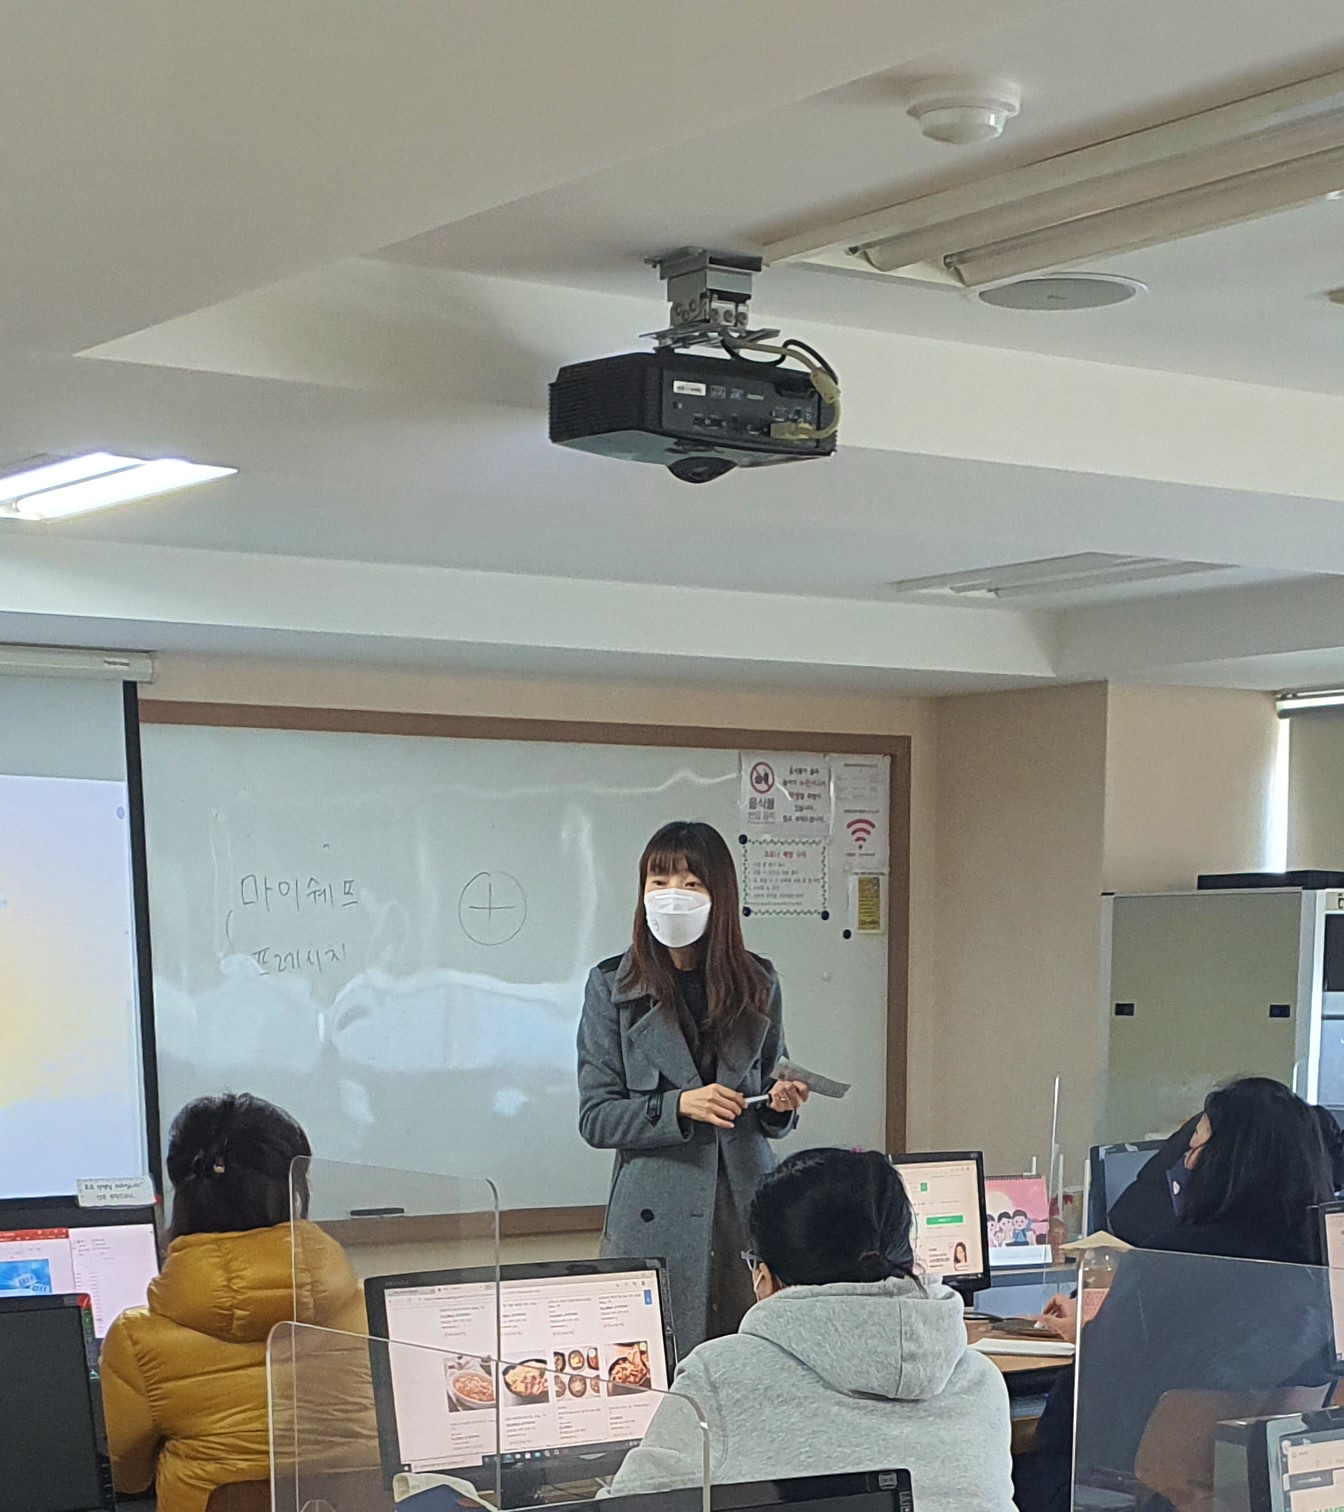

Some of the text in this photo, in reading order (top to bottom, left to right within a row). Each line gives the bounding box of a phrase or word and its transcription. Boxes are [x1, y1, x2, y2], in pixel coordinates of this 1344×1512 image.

[749, 797, 775, 810] 음식물
[241, 874, 358, 912] 마이쉐프
[252, 943, 346, 976] 프레시지
